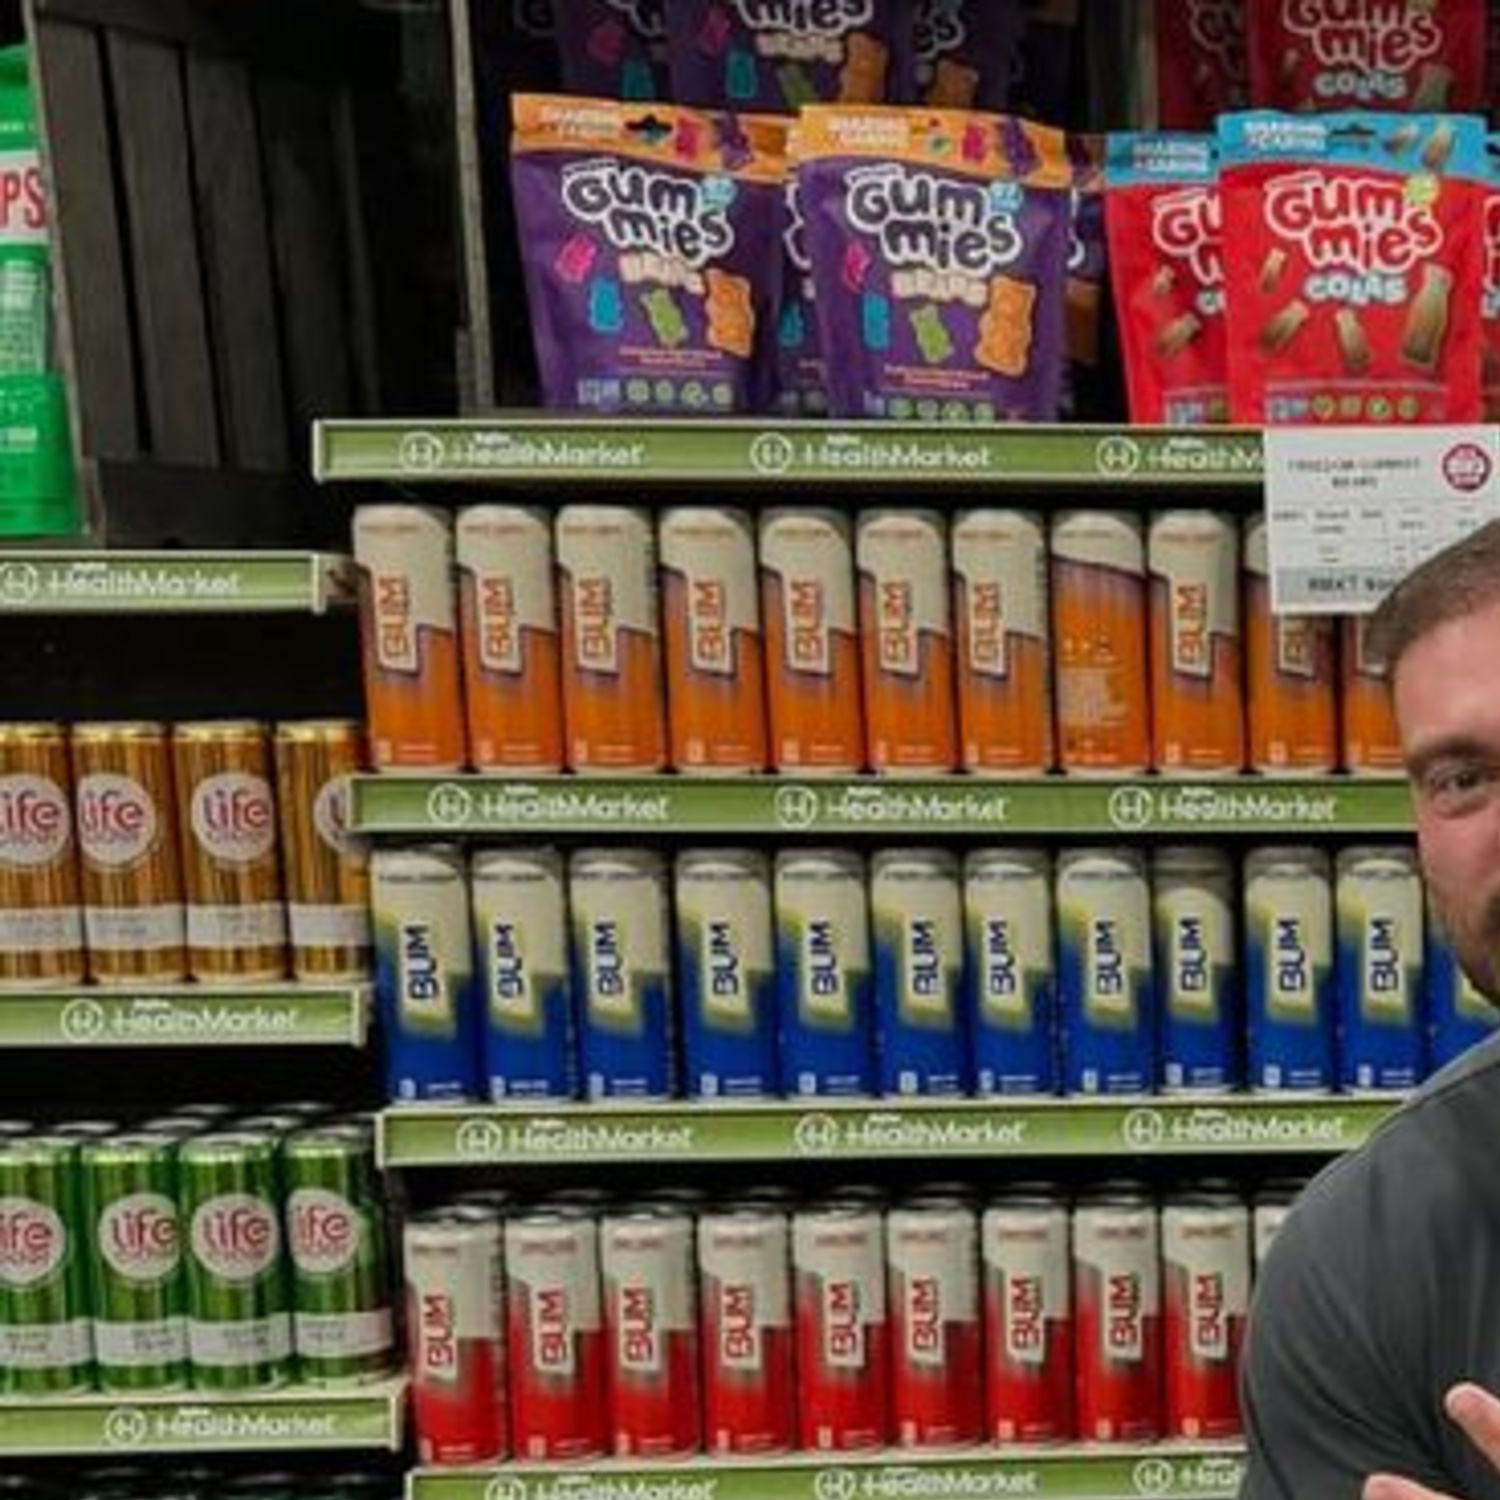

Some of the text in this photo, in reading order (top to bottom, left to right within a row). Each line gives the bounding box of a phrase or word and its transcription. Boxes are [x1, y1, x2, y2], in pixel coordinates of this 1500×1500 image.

[881, 216, 1022, 276] mies
[1304, 205, 1440, 272] mies
[1147, 443, 1264, 468] HealthM
[377, 577, 410, 656] BUM
[480, 578, 510, 655] BUM
[579, 578, 609, 656] BUM
[697, 580, 722, 658] BUM
[794, 580, 819, 658] BUM
[885, 580, 909, 663] BUM
[974, 582, 1002, 660] BUM
[1175, 584, 1206, 663] BUM
[203, 786, 270, 828] life
[405, 925, 437, 999] BUM
[495, 924, 524, 998] BUM
[594, 921, 625, 997] BUM
[710, 923, 739, 997] BUM
[810, 921, 839, 996] BUM
[912, 920, 939, 994] BUM
[990, 920, 1016, 995] BUM
[1095, 920, 1122, 994] BUM
[1181, 918, 1208, 991] BUM
[1278, 919, 1306, 991] BUM
[1372, 918, 1399, 991] BUM
[0, 1212, 53, 1249] ife
[112, 1209, 179, 1248] life
[203, 1209, 272, 1248] life
[422, 1295, 452, 1367] BUM
[538, 1290, 568, 1363] BUM
[624, 1288, 653, 1361] BUM
[725, 1287, 752, 1358] BUM
[831, 1283, 858, 1356] BUM
[912, 1276, 941, 1349] BUM
[1013, 1277, 1041, 1348] BUM
[1110, 1275, 1139, 1346] BUM
[1196, 1274, 1223, 1344] BUM
